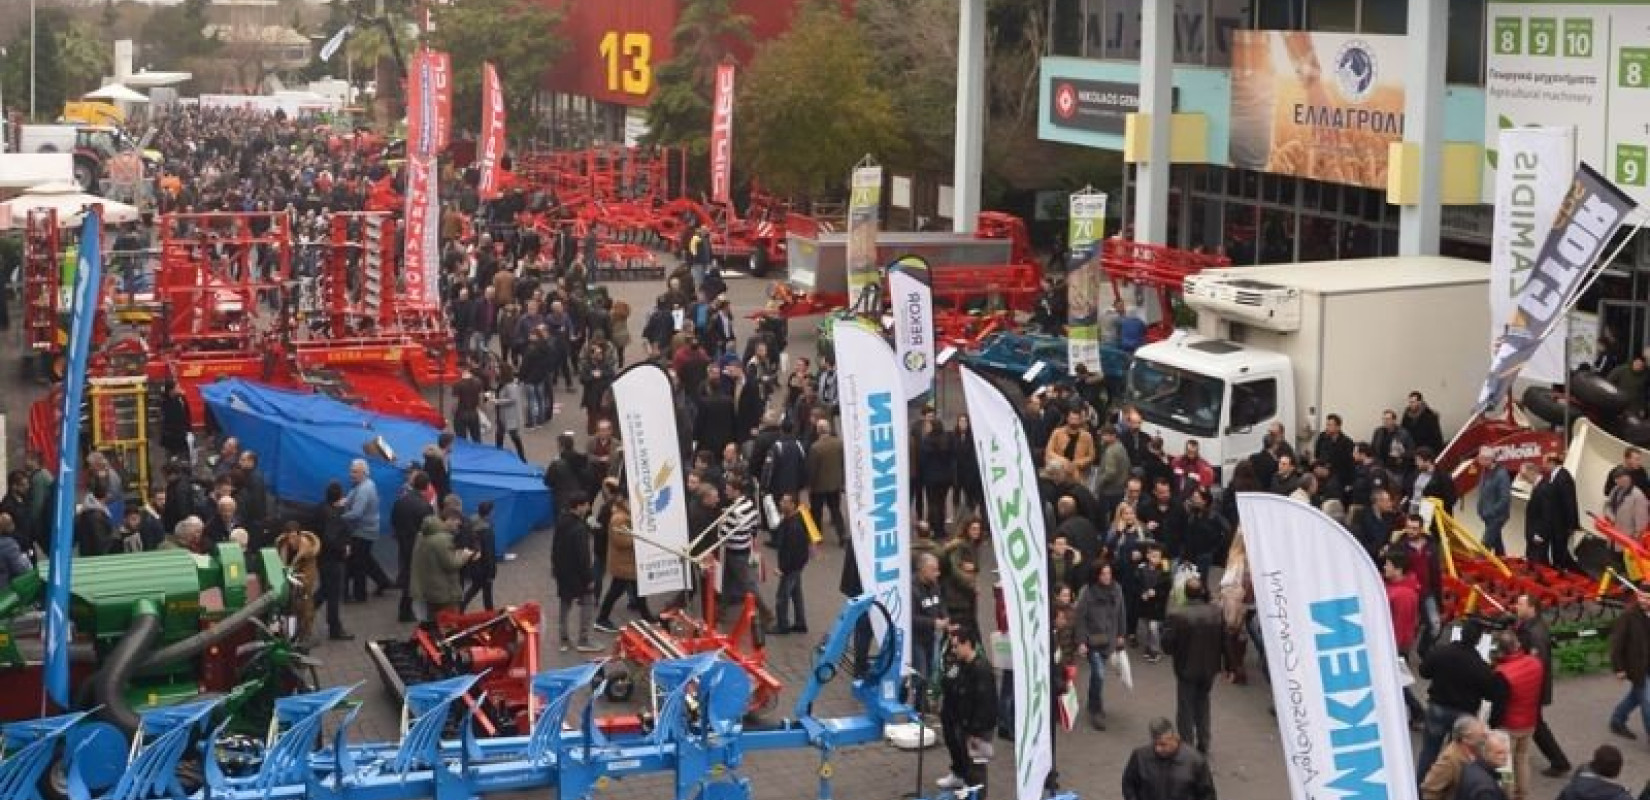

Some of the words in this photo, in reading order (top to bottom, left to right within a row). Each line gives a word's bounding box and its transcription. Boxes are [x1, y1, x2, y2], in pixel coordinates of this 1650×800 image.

[1501, 30, 1515, 52] 8
[1535, 31, 1549, 53] 9
[1567, 32, 1589, 55] 10
[600, 31, 651, 94] 13
[1627, 62, 1642, 84] 8
[1624, 159, 1639, 182] 9
[1073, 220, 1094, 240] 70
